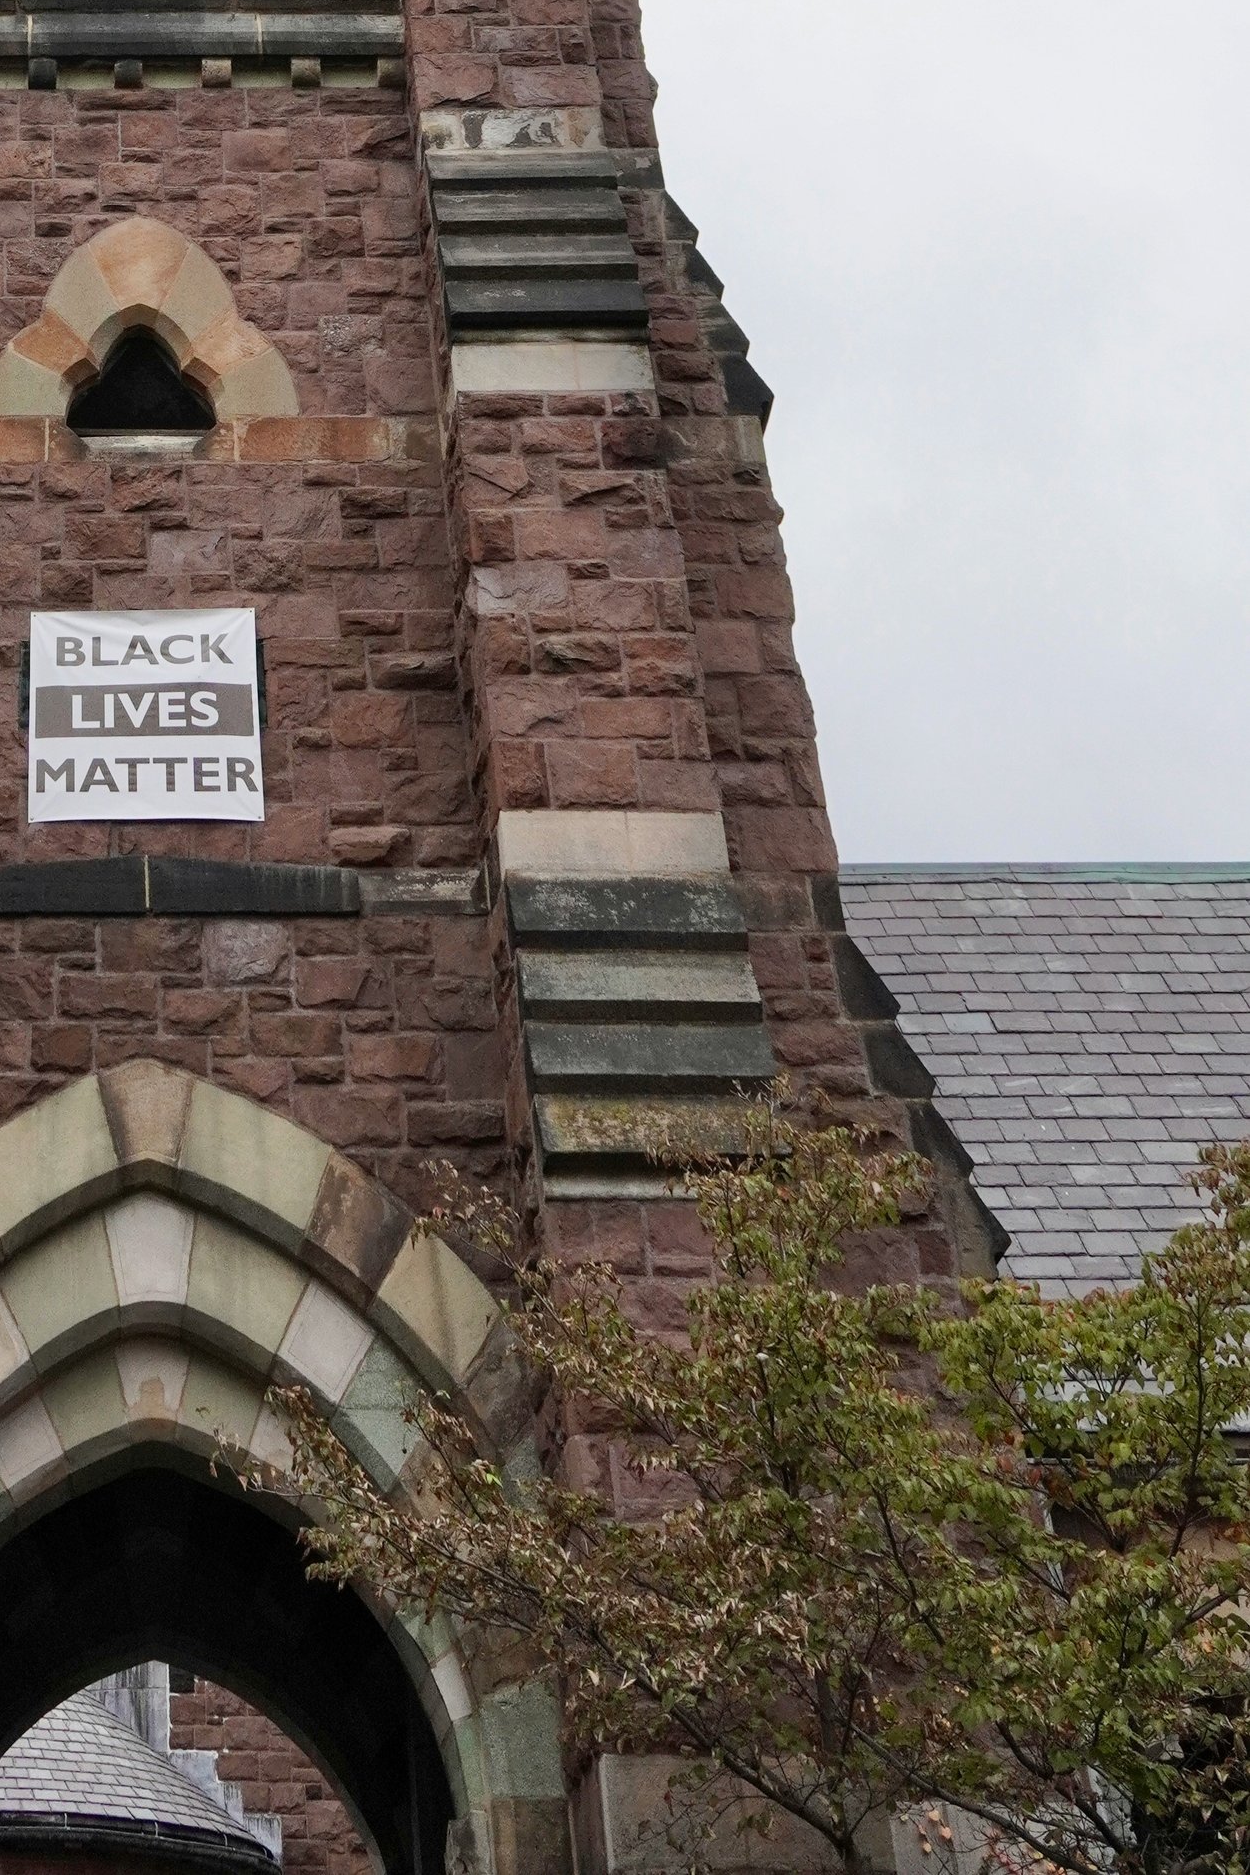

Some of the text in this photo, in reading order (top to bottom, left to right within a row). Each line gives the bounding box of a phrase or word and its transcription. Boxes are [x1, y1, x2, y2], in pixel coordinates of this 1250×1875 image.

[56, 633, 234, 667] BLACK
[71, 691, 220, 729] LIVES
[36, 757, 259, 793] MATTER
